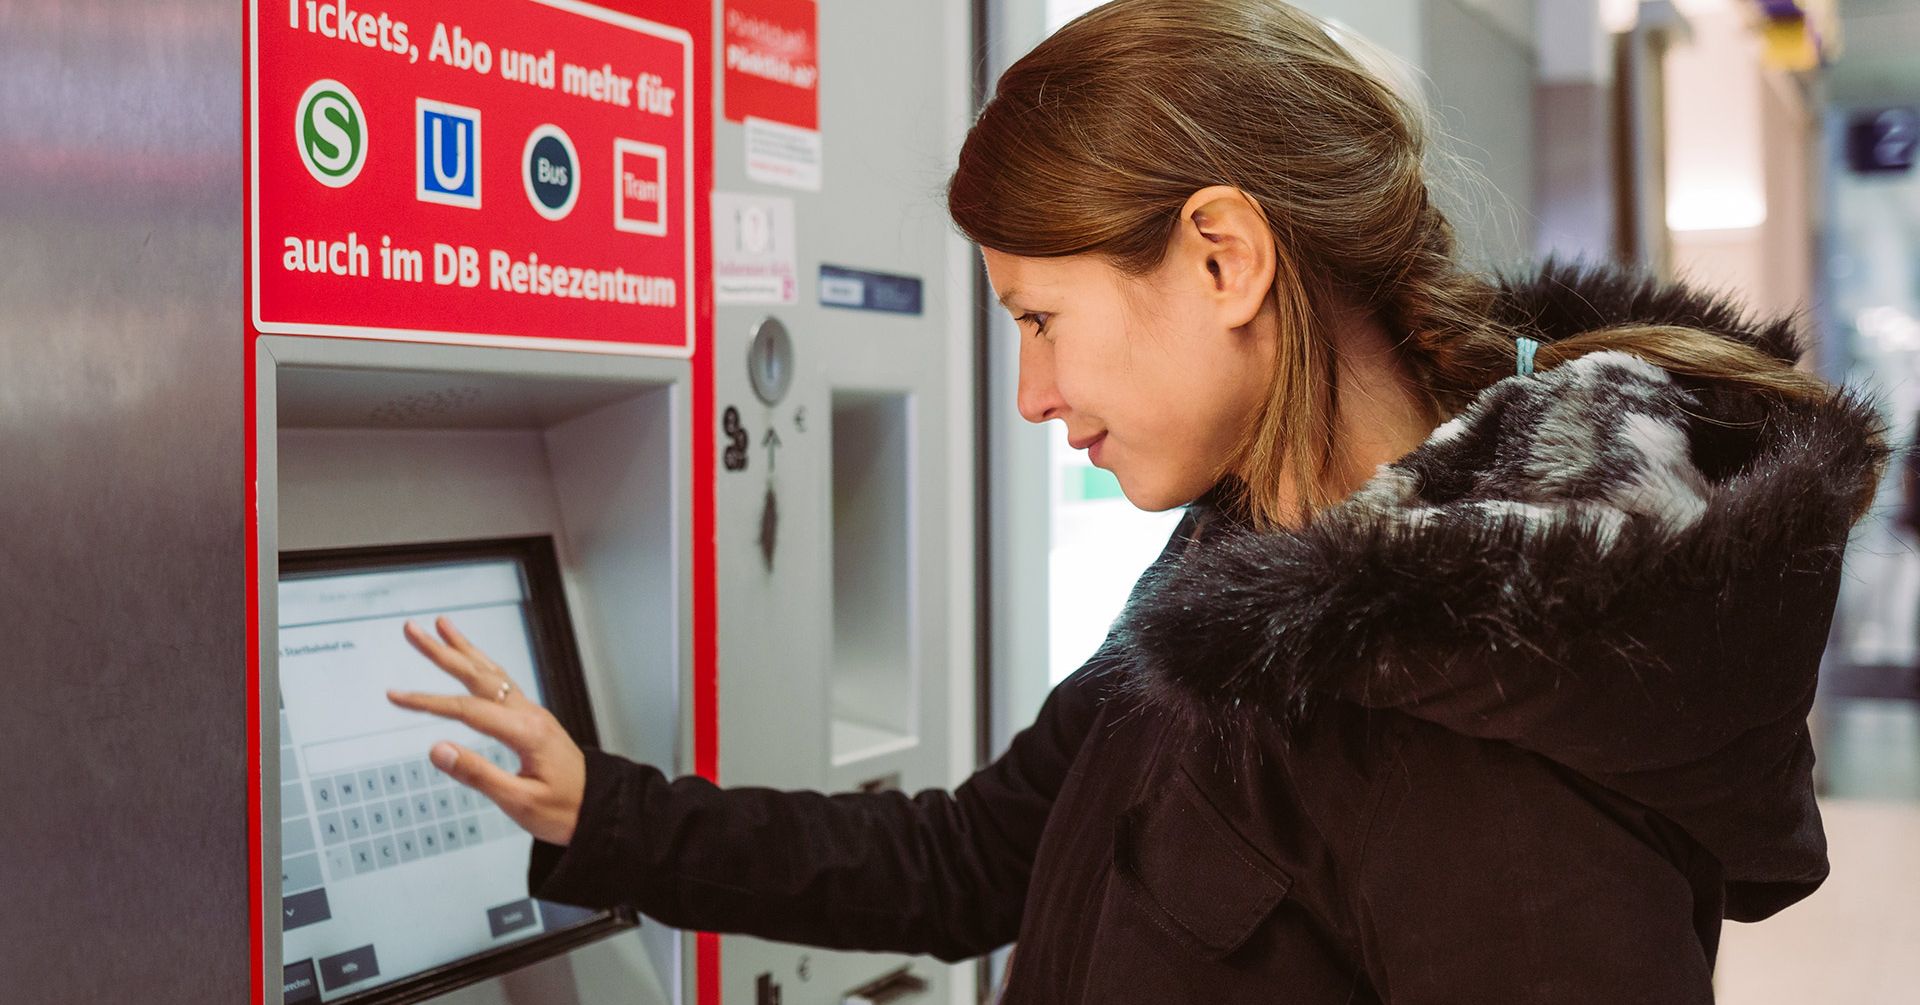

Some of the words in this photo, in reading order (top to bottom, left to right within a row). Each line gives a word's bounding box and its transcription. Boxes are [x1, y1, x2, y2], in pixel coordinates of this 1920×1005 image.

[428, 22, 493, 75] Abo
[500, 48, 556, 90] und
[562, 63, 633, 107] mehr
[636, 71, 676, 117] für
[311, 100, 353, 173] S
[432, 117, 467, 191] U
[537, 157, 569, 187] Bus
[282, 232, 370, 277] auch
[380, 235, 423, 283] im
[433, 242, 481, 288] DB
[489, 249, 677, 308] Reisezentrum
[319, 787, 329, 801] Q
[328, 823, 338, 835] A
[374, 812, 384, 825] D
[382, 845, 391, 858] C
